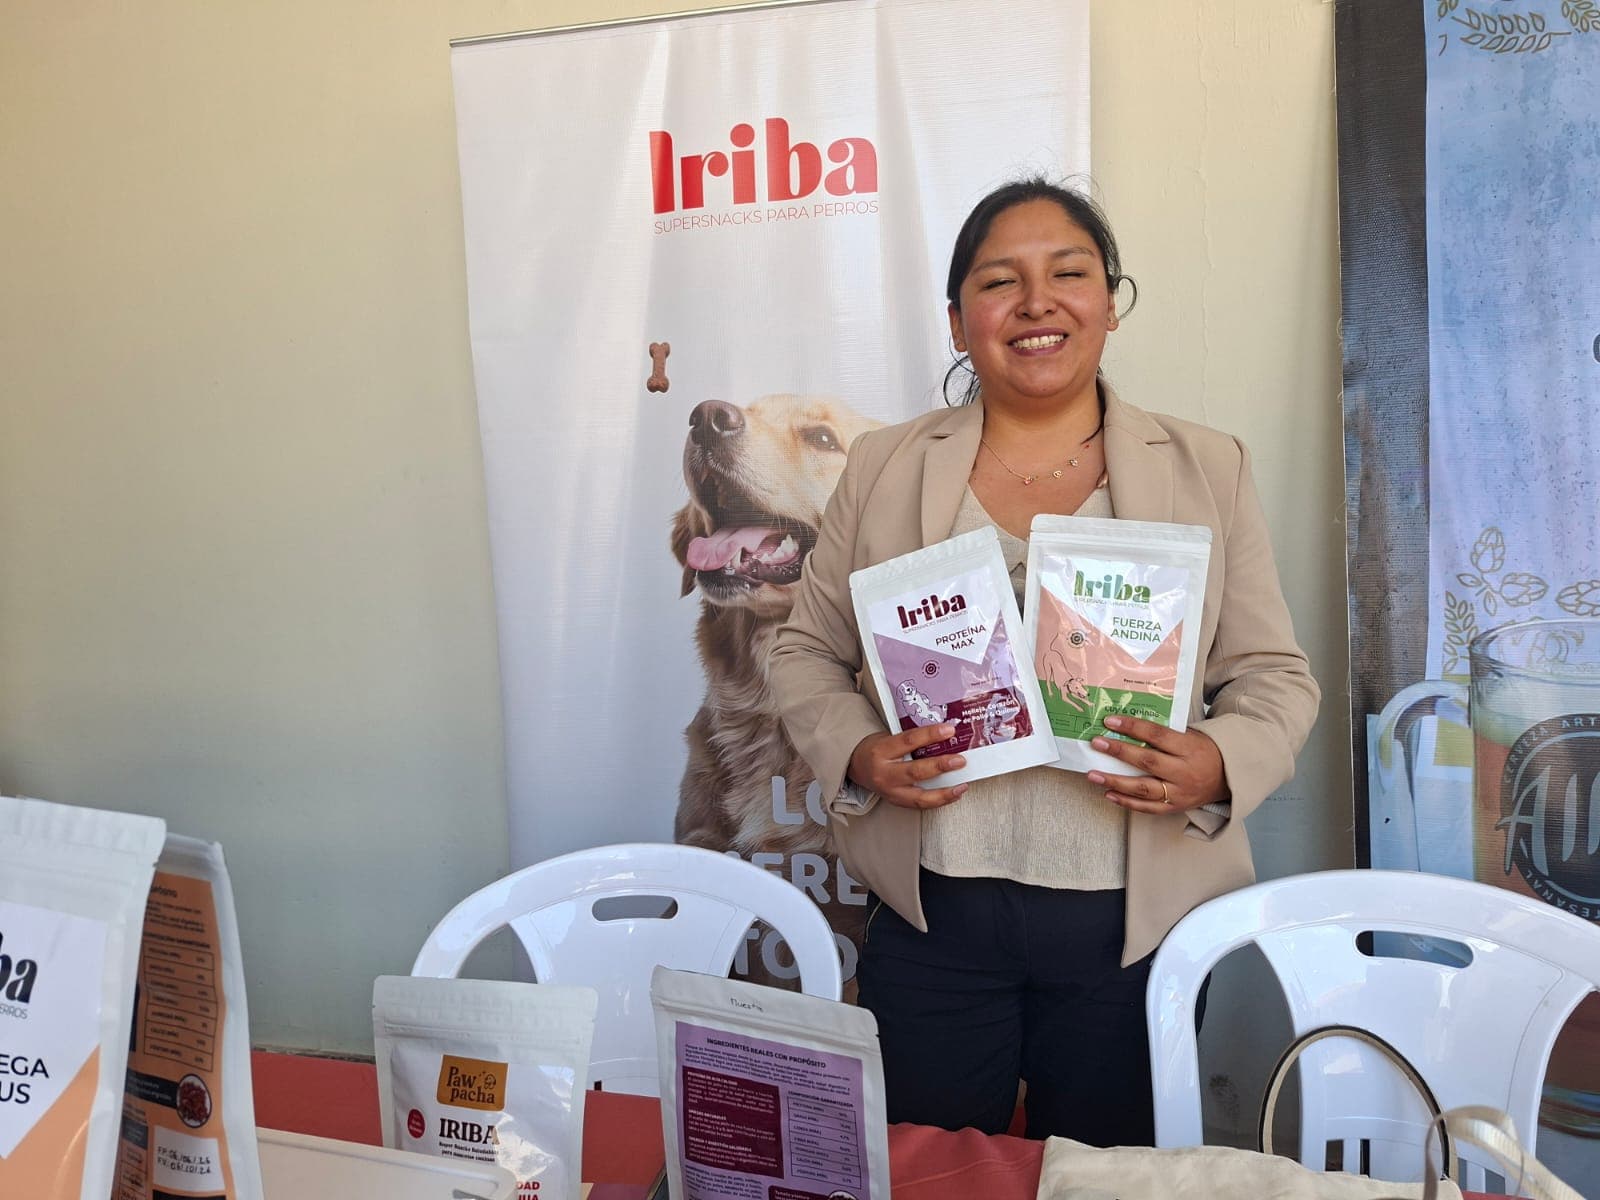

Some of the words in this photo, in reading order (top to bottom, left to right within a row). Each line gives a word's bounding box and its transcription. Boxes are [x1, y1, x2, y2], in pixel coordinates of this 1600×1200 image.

[649, 118, 878, 214] Iriba
[654, 210, 762, 234] SUPERSNACKS
[767, 206, 809, 222] PARA
[814, 200, 879, 217] PERROS
[1074, 570, 1151, 604] Iriba
[897, 594, 966, 629] Iriba
[935, 624, 986, 646] PROTEÍNA
[1110, 628, 1161, 642] ANDINA
[1113, 616, 1162, 632] FUERZA
[951, 638, 975, 650] MAX
[1122, 706, 1128, 714] &
[707, 1038, 750, 1052] INGREDIENTES
[750, 1046, 774, 1058] REALES
[775, 1052, 788, 1062] CON
[789, 1054, 826, 1068] PROPÓSITO
[447, 1066, 476, 1088] Paw
[450, 1088, 495, 1104] pacha
[438, 1118, 500, 1145] IRIBA
